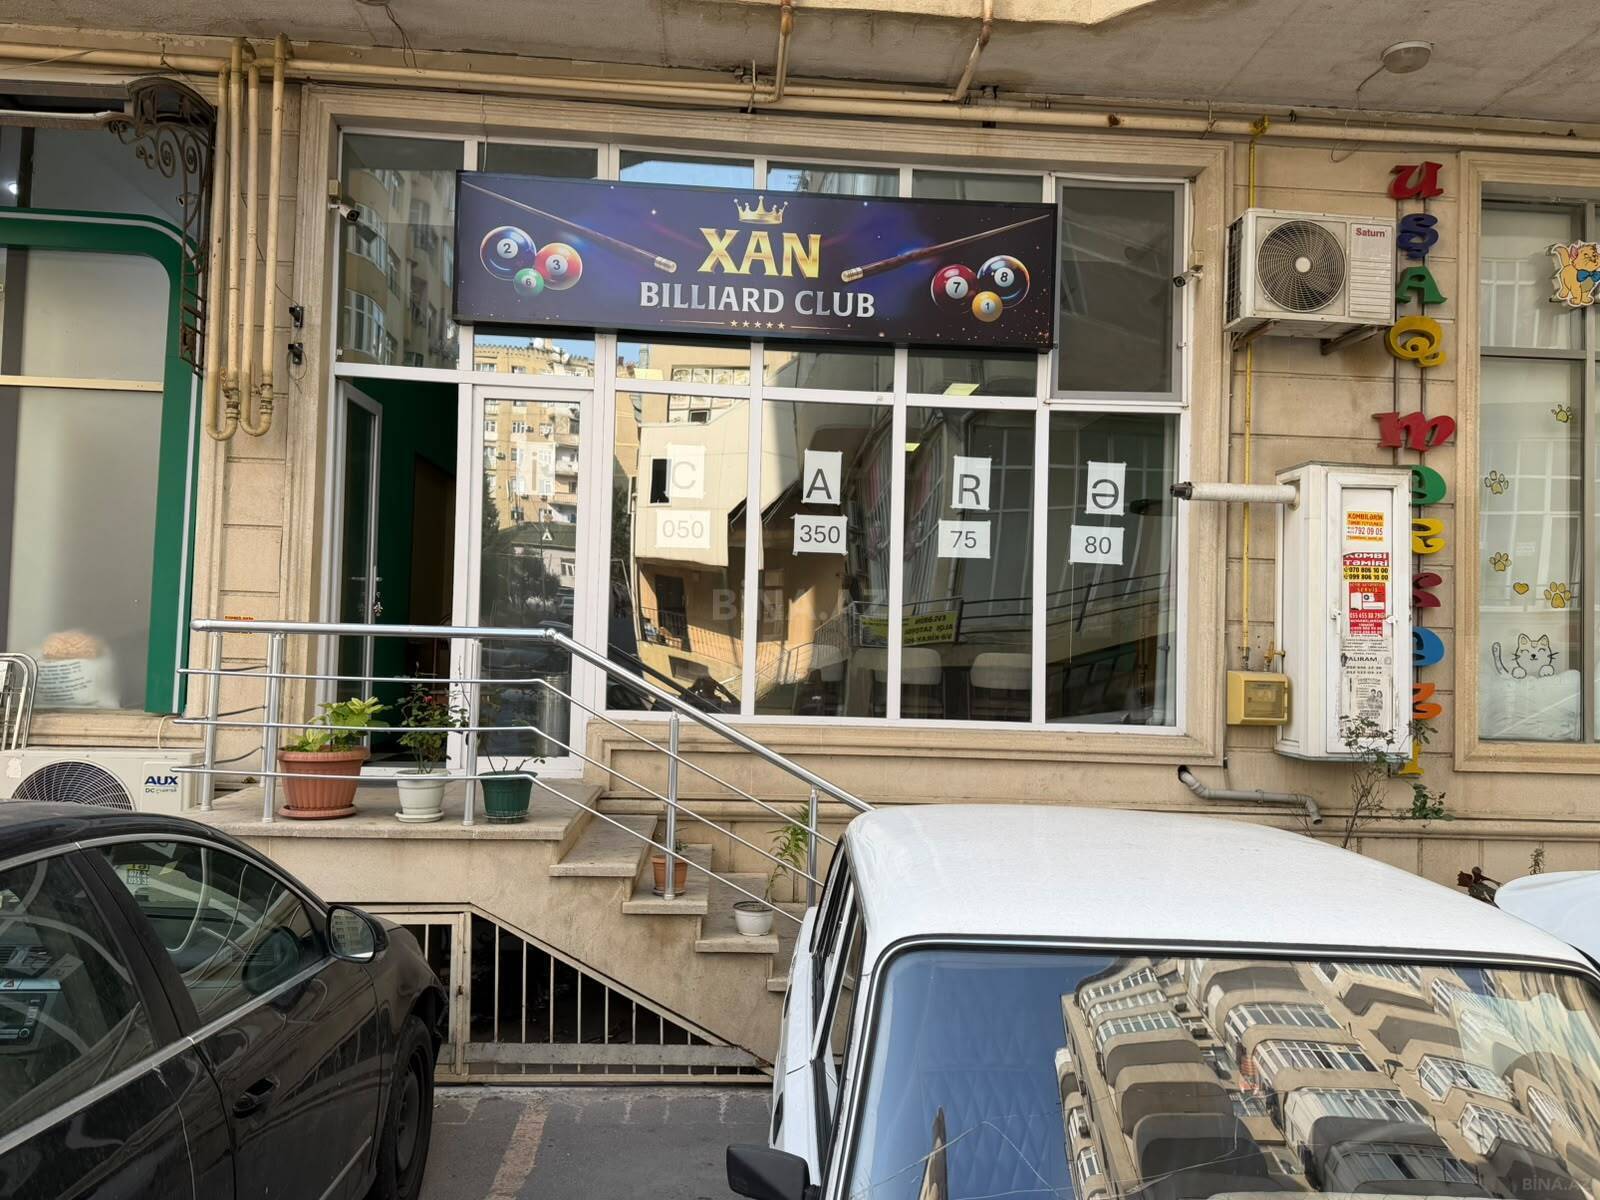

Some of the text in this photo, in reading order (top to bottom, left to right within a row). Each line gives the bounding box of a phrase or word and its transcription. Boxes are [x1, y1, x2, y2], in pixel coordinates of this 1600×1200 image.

[1355, 227, 1386, 238] Saturn
[503, 243, 512, 254] 2
[697, 227, 822, 279] XAN
[552, 259, 561, 271] 3
[1001, 272, 1008, 283] 8
[953, 282, 961, 292] 7
[639, 281, 876, 319] BILLIARD CLUB
[805, 468, 832, 500] A
[957, 474, 982, 506] R
[1091, 479, 1120, 510] Ə
[662, 519, 1112, 555] 050 350 75 80
[144, 776, 178, 785] AUX
